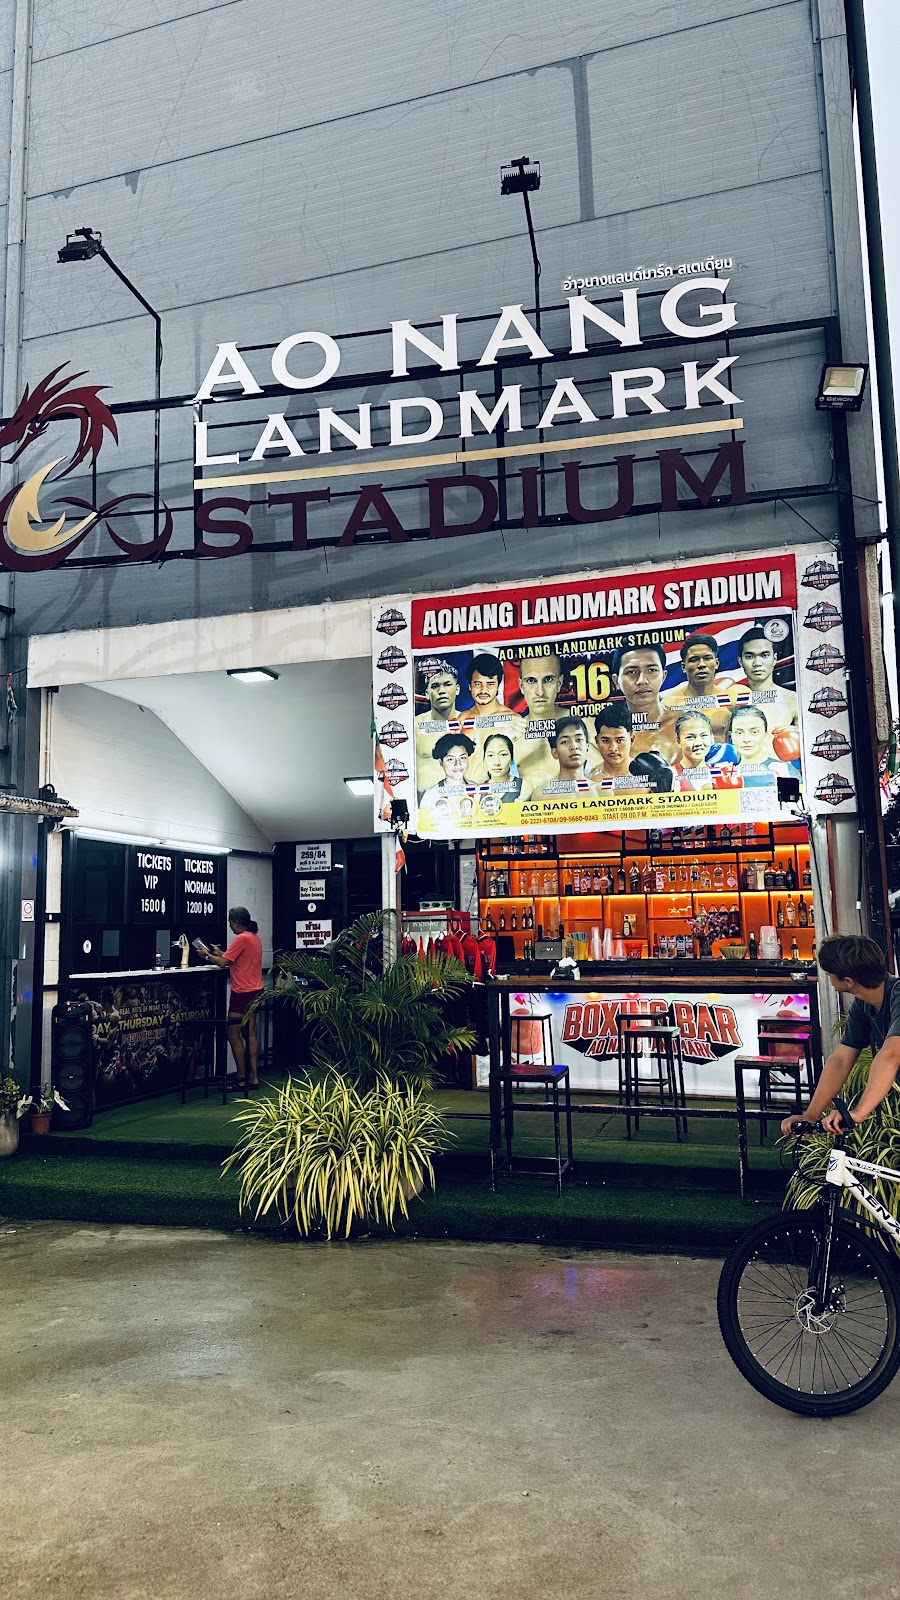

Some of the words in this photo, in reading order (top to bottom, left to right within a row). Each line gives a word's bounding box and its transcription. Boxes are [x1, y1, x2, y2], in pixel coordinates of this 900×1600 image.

[563, 263, 674, 291] อ่าวนางแลนด์มาร์ค
[678, 255, 733, 275] สเตเดียม
[193, 331, 342, 402] AO
[390, 277, 740, 378] NANG
[193, 356, 744, 467] LANDMARK
[195, 440, 747, 557] STADIUM
[422, 602, 514, 637] AONANG
[521, 585, 657, 626] LANDMARK
[663, 570, 782, 611] STADIUM
[499, 649, 514, 661] AO
[519, 644, 550, 660] NANG
[555, 635, 623, 655] LANDMARK
[628, 629, 685, 648] STADIUM
[570, 662, 610, 701] 16
[528, 720, 556, 732] ALEXIS
[632, 712, 648, 724] NUT
[525, 731, 545, 740] EMERALD
[545, 730, 556, 738] GYM
[522, 804, 538, 812] AO
[544, 802, 577, 810] NANG
[583, 797, 653, 808] LANDMARK
[658, 794, 717, 804] STADIUM
[137, 853, 172, 871] TICKETS
[301, 851, 326, 860] 259/84
[184, 858, 213, 874] TICKETS
[144, 875, 158, 889] VIP
[184, 880, 216, 894] NORMAL
[141, 899, 160, 912] 1500
[187, 901, 202, 914] 1200
[118, 1015, 164, 1030] THURSDAY
[170, 1009, 210, 1023] SATURDAY
[672, 1002, 742, 1047] BAR
[586, 1039, 606, 1056] AO
